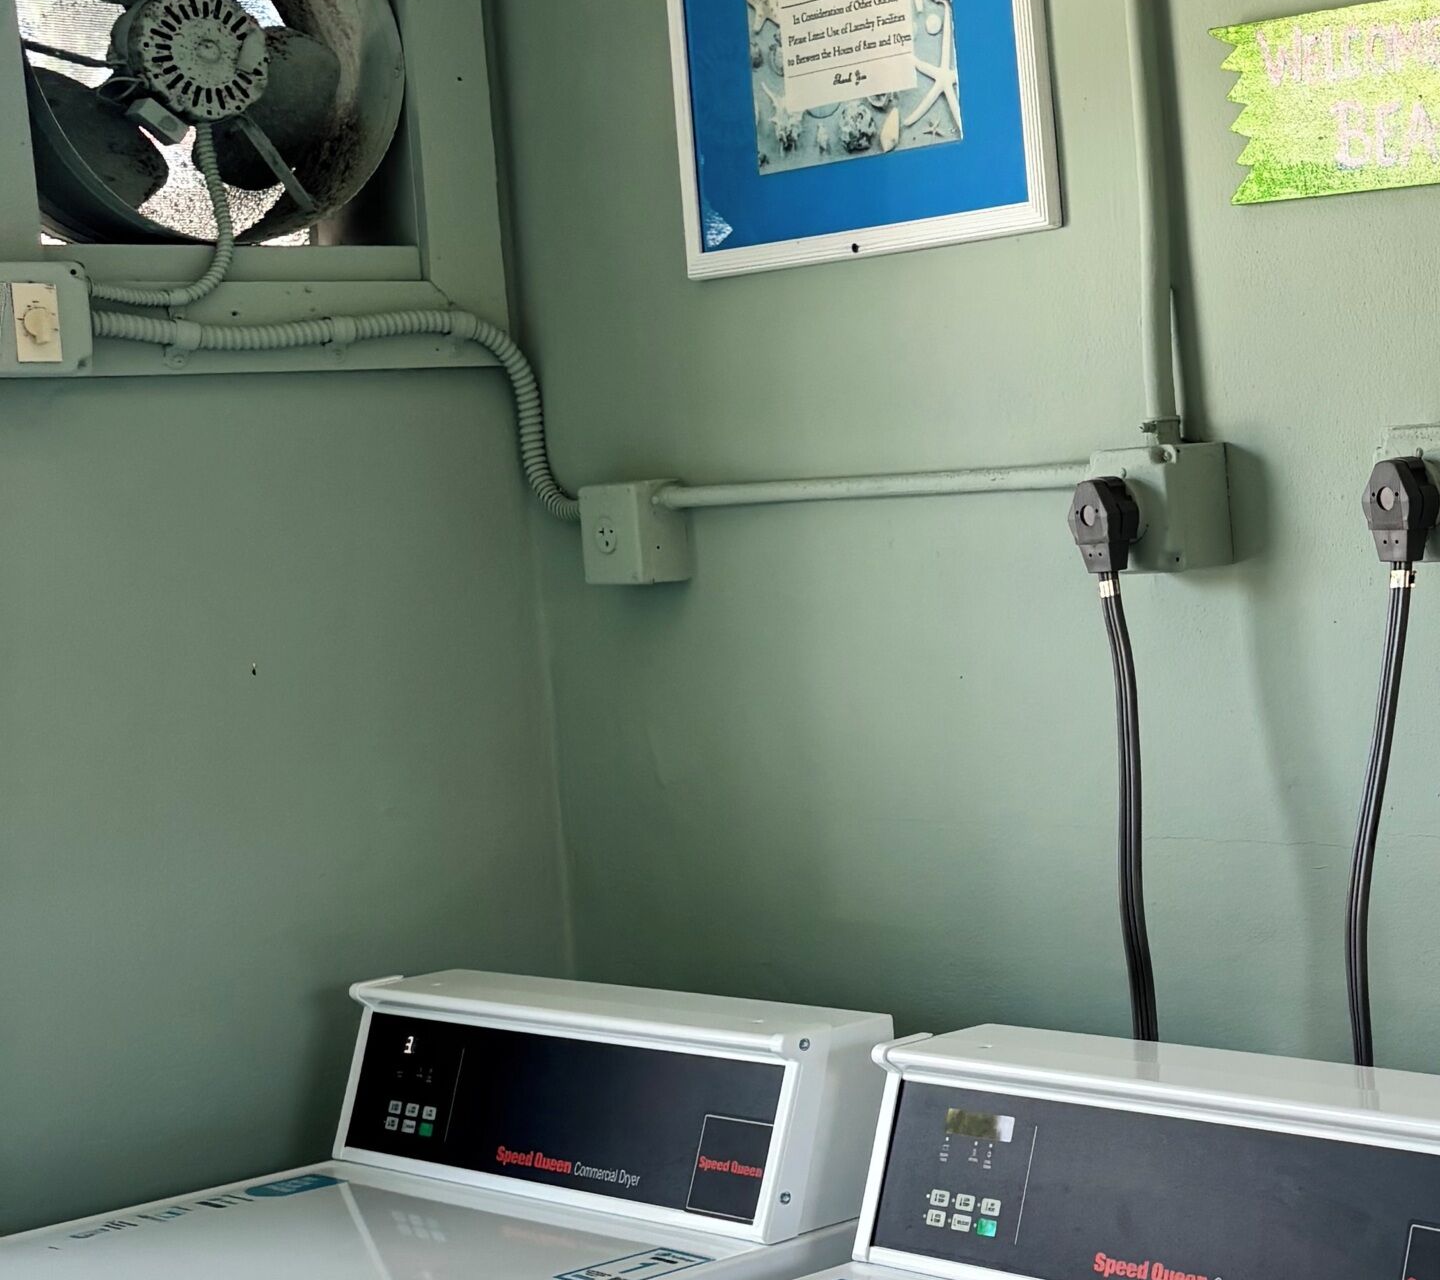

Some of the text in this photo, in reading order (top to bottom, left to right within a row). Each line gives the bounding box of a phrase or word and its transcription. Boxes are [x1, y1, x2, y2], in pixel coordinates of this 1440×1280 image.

[496, 1146, 641, 1188] Speed Queen Commercial Dryer
[699, 1155, 763, 1178] Speed Queen
[1093, 1252, 1149, 1280] Speed
